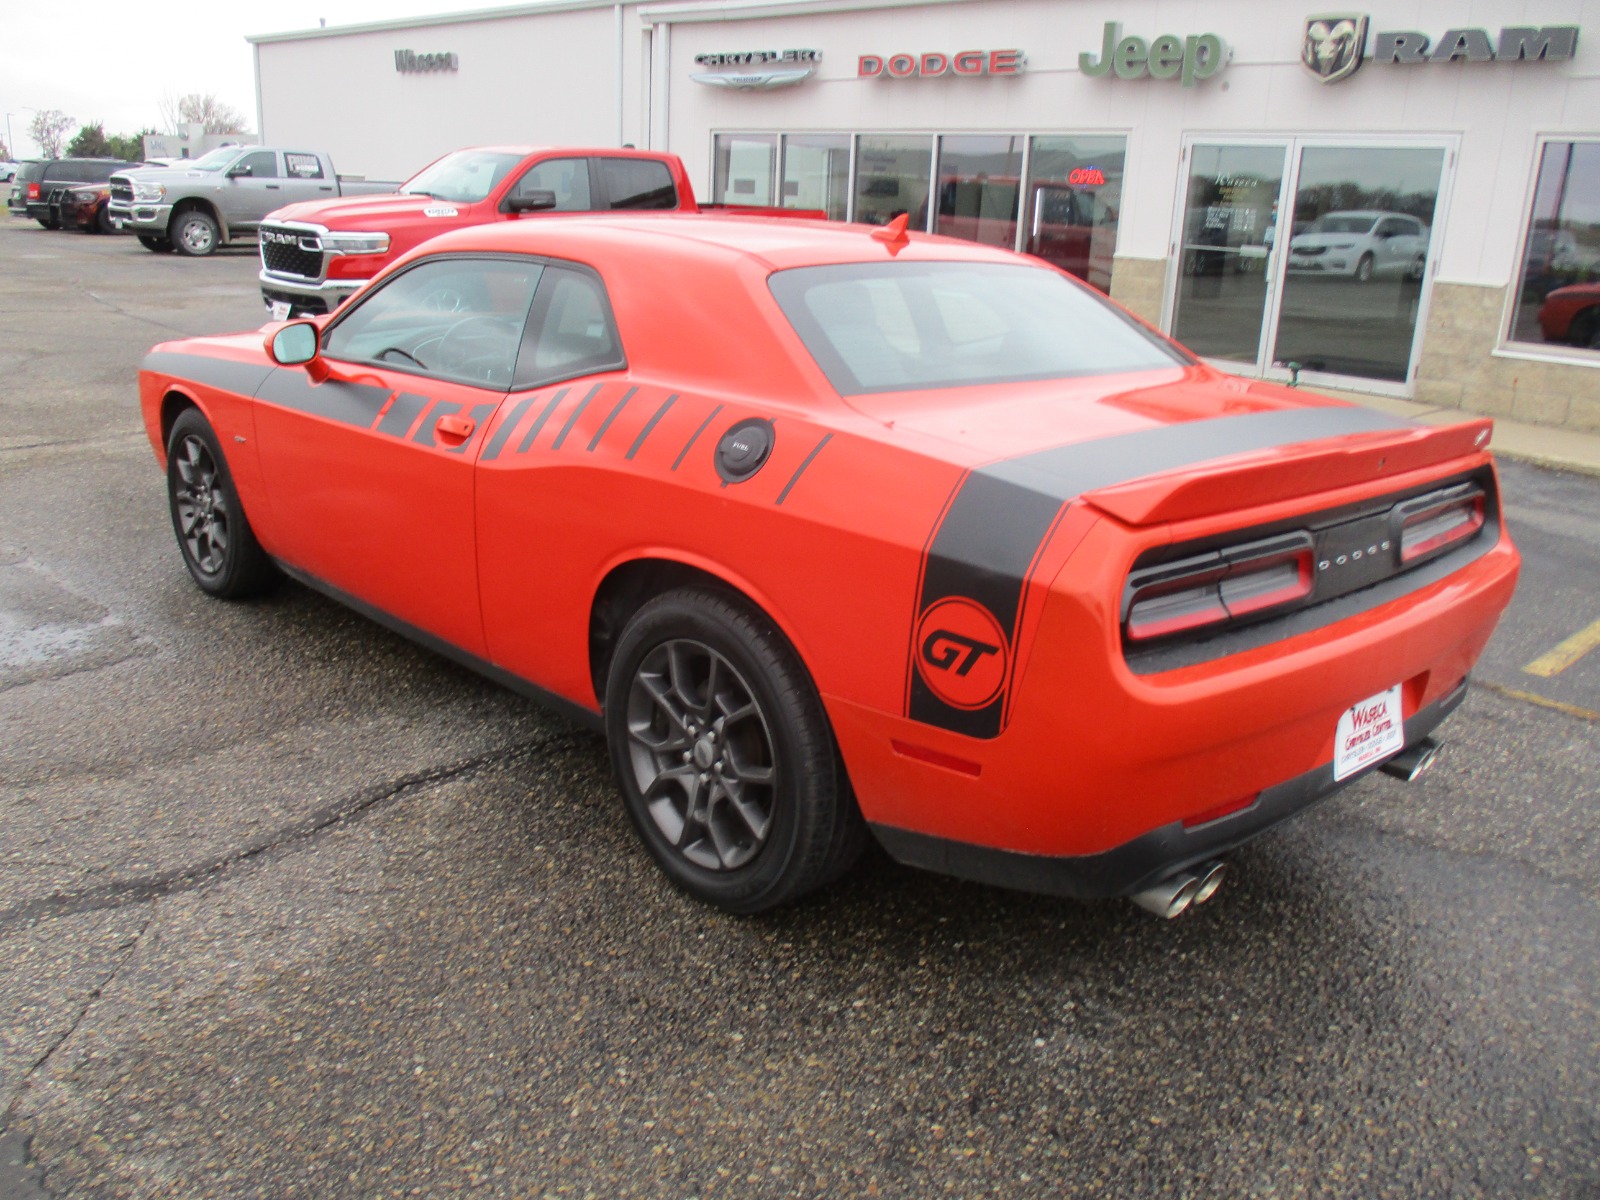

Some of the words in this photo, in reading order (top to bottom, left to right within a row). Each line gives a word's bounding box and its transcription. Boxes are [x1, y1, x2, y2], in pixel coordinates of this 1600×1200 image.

[694, 50, 822, 65] CHRYSLER
[1078, 21, 1229, 88] Jeep
[1374, 26, 1579, 63] RAM
[857, 50, 1024, 78] DODGE
[1069, 167, 1105, 185] OPEN
[265, 232, 297, 245] RAM
[732, 441, 749, 451] FUEL
[1318, 540, 1390, 571] DODGE
[922, 629, 1000, 677] GT
[1351, 702, 1388, 732] WASECA
